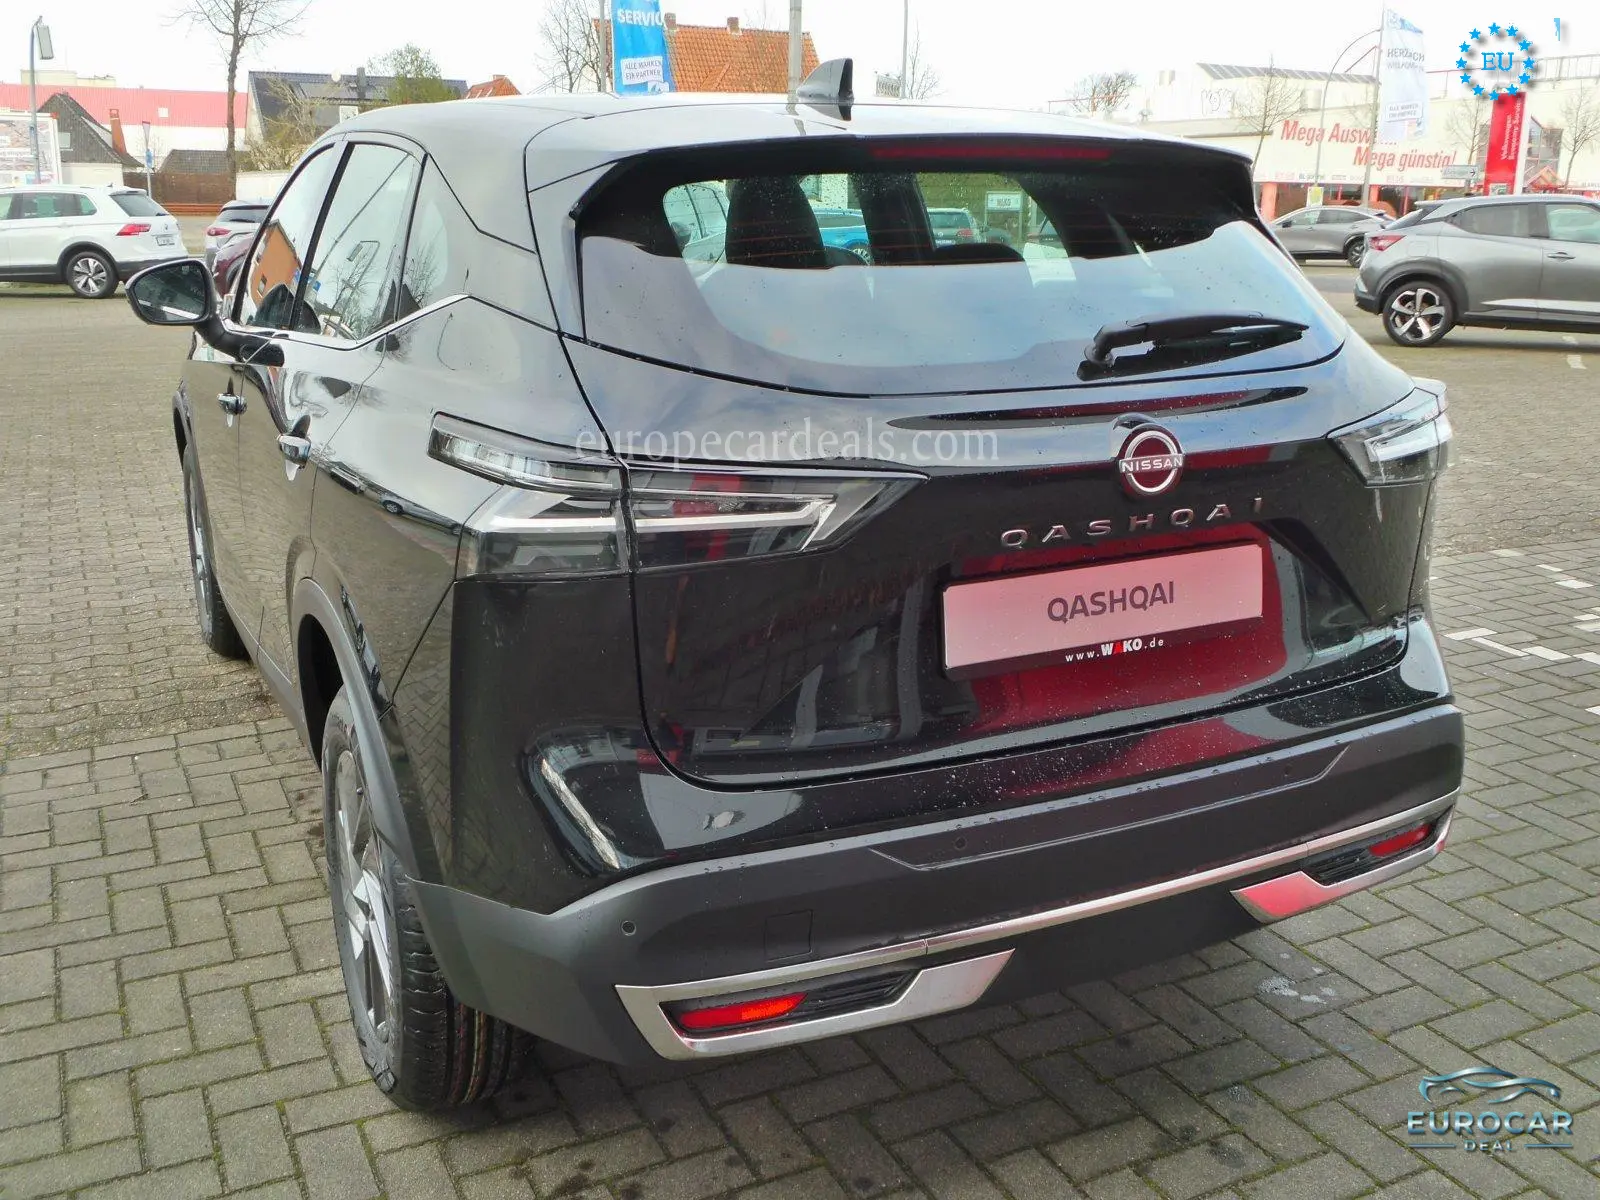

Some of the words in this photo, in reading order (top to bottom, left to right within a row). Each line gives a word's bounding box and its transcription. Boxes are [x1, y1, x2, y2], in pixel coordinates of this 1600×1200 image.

[617, 8, 663, 26] SERVIC
[1387, 48, 1424, 62] HERZCH
[1281, 120, 1325, 146] Mega
[1328, 123, 1390, 145] Ausw
[1354, 147, 1396, 171] Mega
[1120, 455, 1183, 473] NISSAN
[1001, 497, 1263, 549] QASHQAI
[1047, 581, 1174, 624] QASHQAI
[1065, 637, 1164, 662] www.WAKO.de
